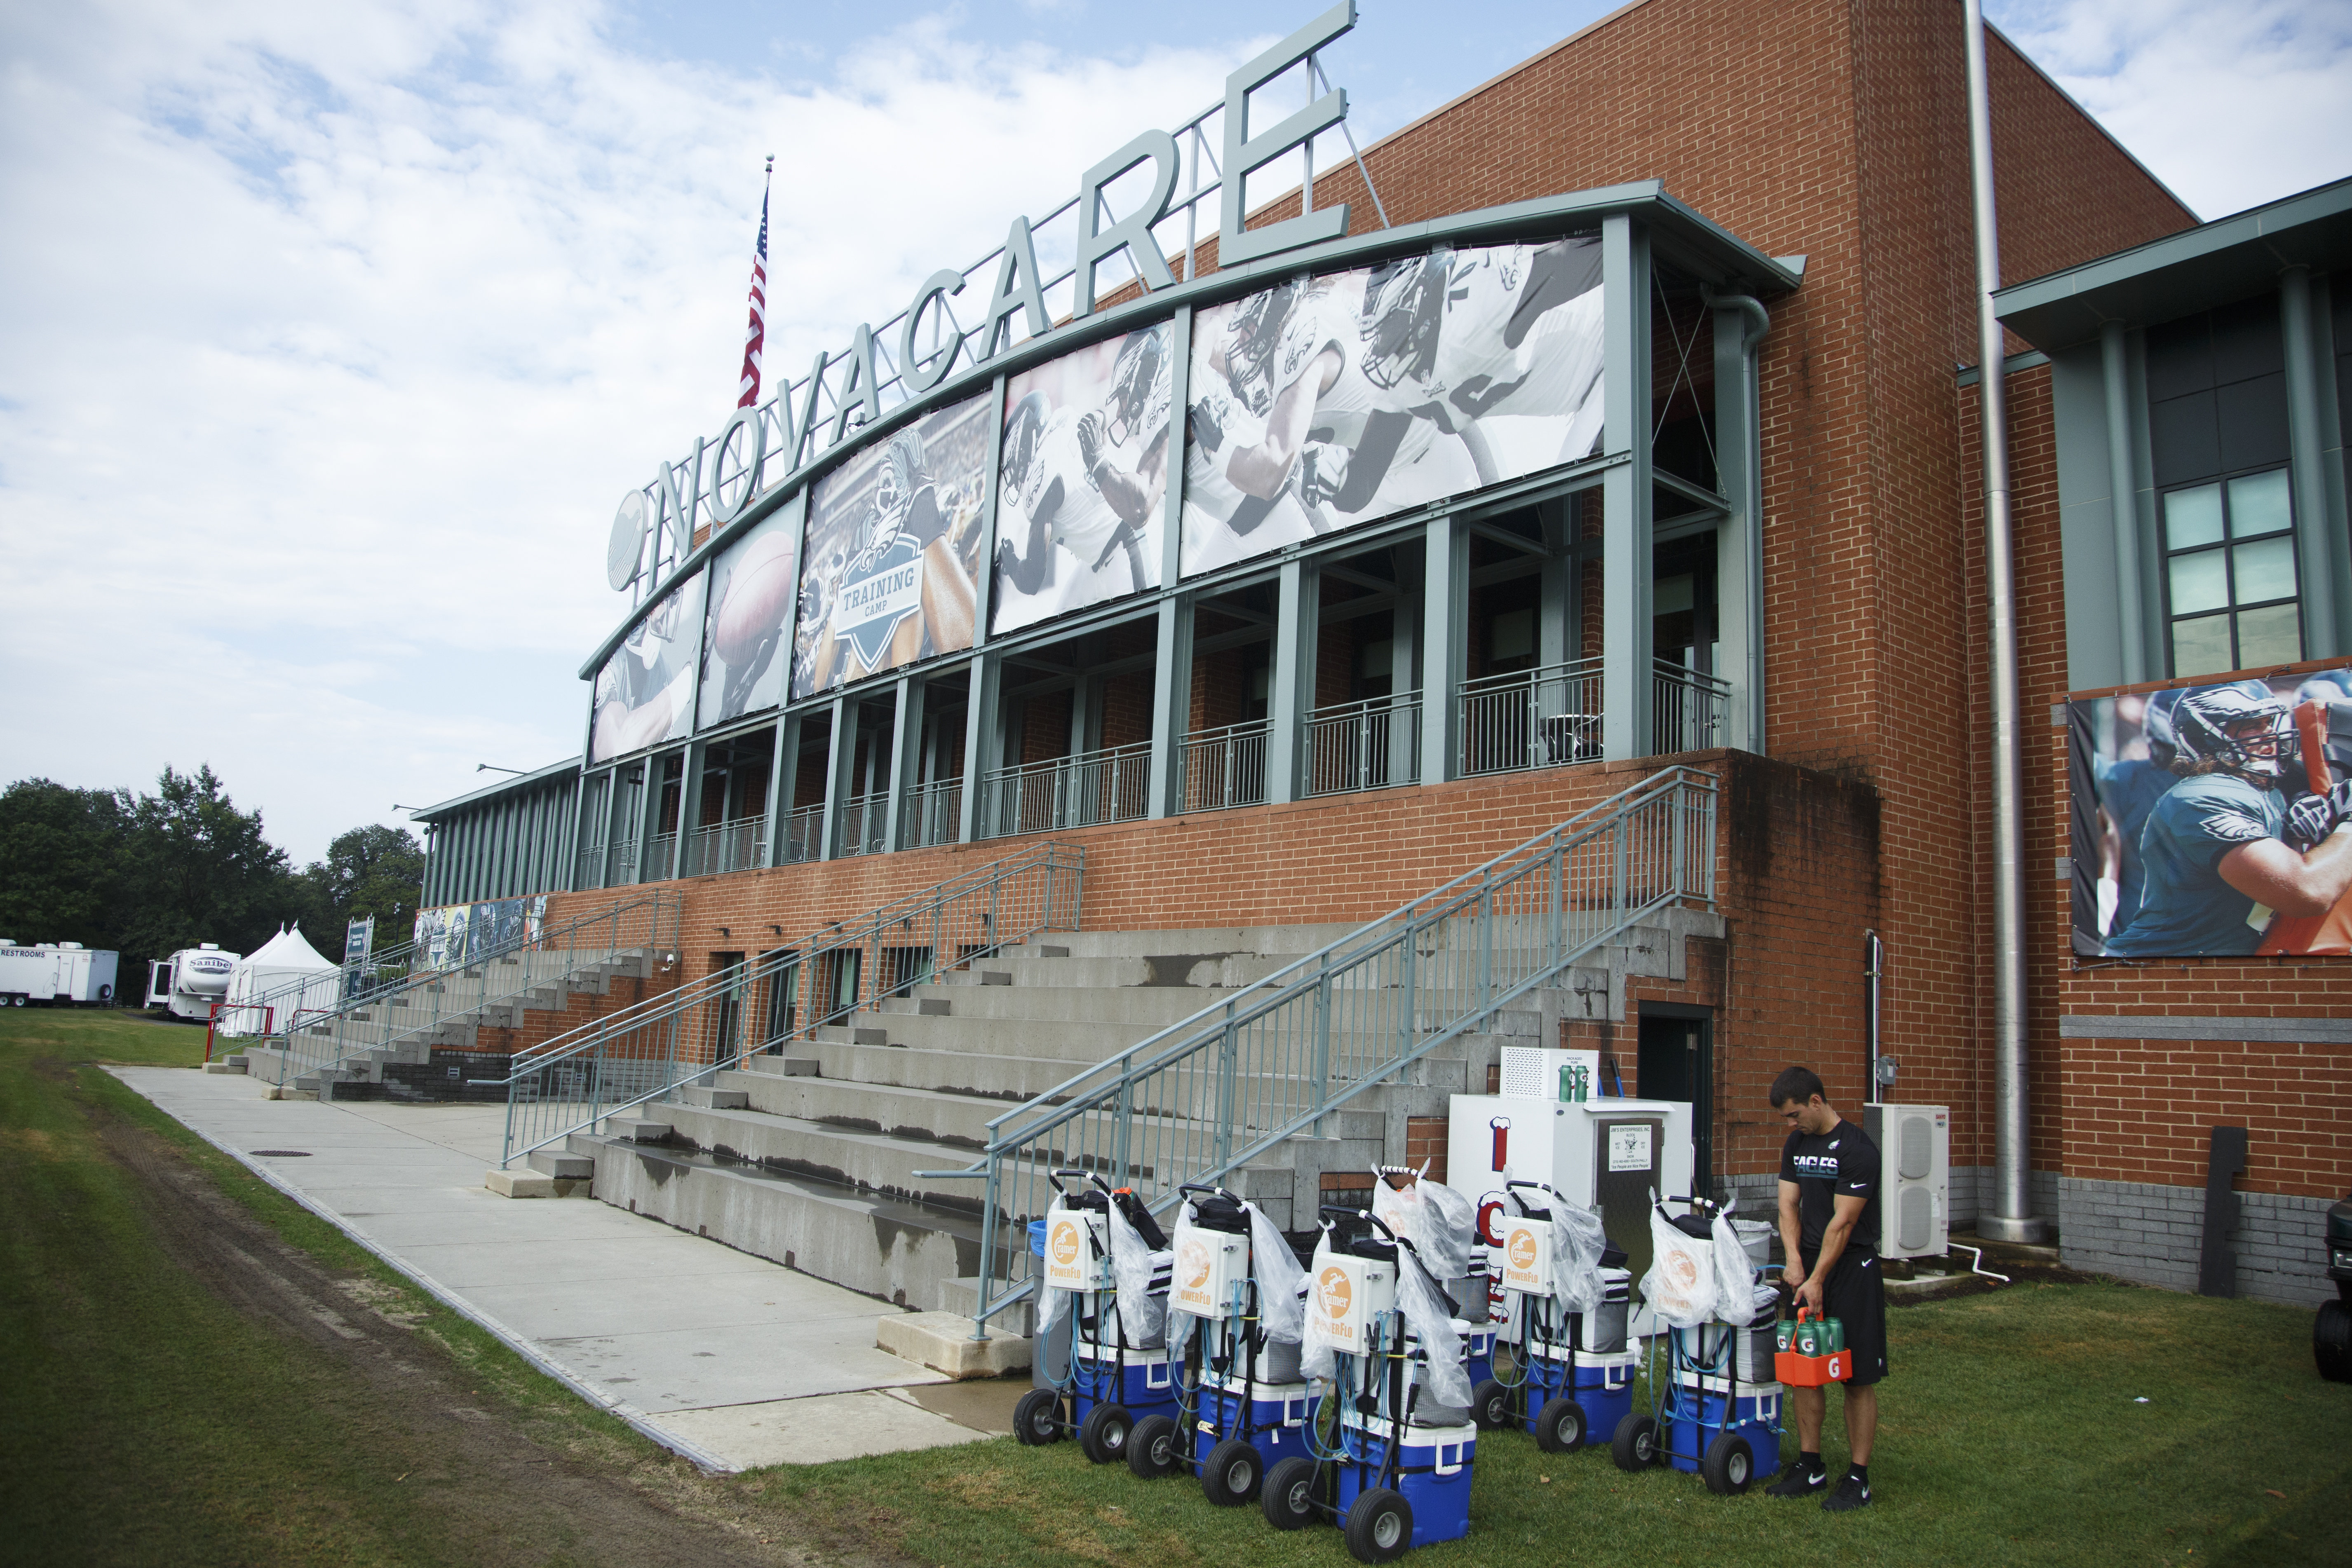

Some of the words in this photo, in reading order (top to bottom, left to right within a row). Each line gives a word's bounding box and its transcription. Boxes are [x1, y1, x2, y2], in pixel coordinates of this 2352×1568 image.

[646, 0, 1356, 596] NOVACARE
[844, 567, 914, 611] TRAINING
[865, 600, 887, 616] CAMP
[1054, 1237, 1076, 1258] Cramer
[1511, 1243, 1534, 1263] Cramer
[1176, 1290, 1211, 1305] OWERFLO
[1777, 1335, 1787, 1349] G
[1801, 1338, 1814, 1352] G
[1829, 1357, 1839, 1378] G
